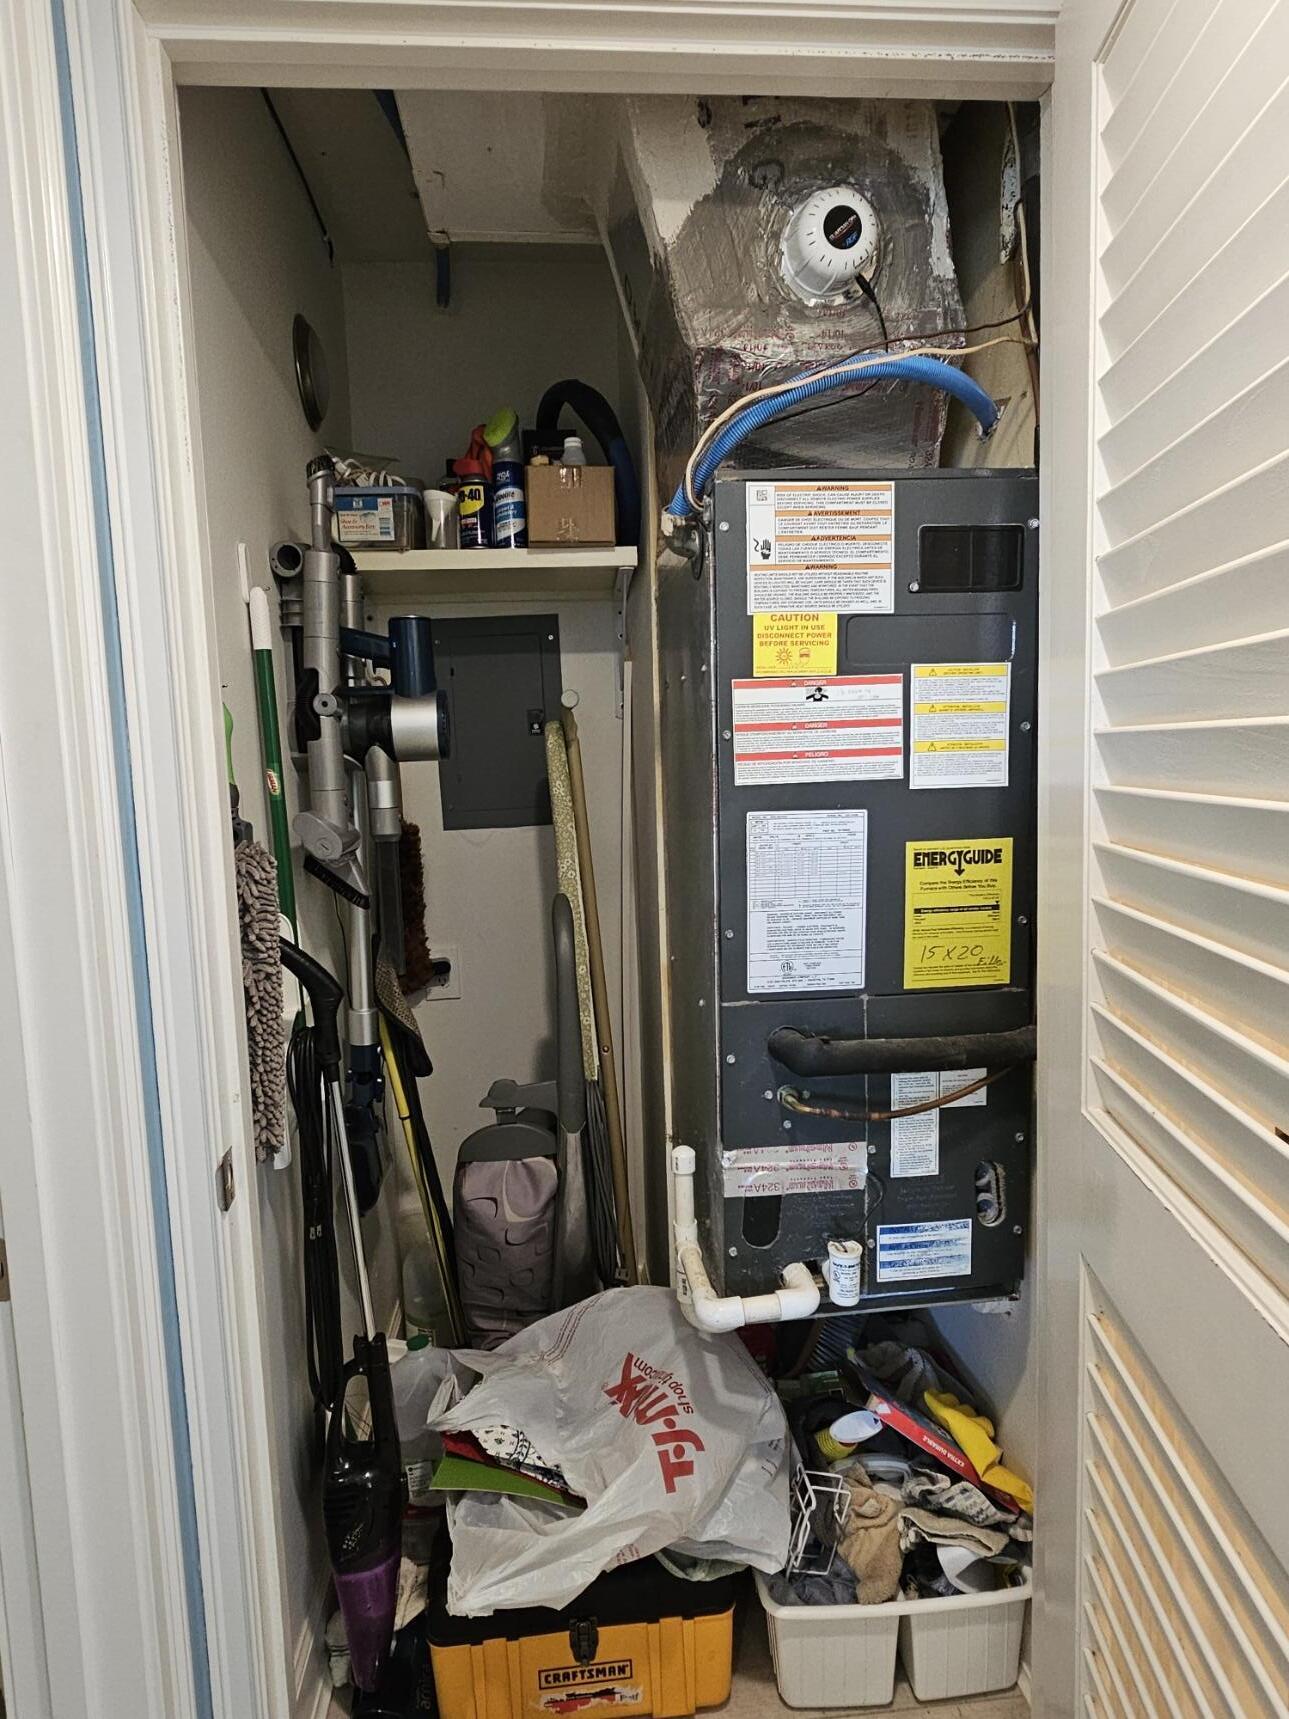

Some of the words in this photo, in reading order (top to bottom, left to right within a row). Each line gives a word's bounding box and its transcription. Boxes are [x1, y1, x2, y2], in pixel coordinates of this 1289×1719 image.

[770, 613, 819, 622] CAUTION
[914, 849, 1002, 868] ENERGYGUIDE
[920, 945, 945, 963] 15
[957, 944, 984, 960] 20
[753, 1182, 780, 1193] 324A
[668, 1379, 694, 1414] shop
[544, 1665, 628, 1684] CRAFTSMAN
